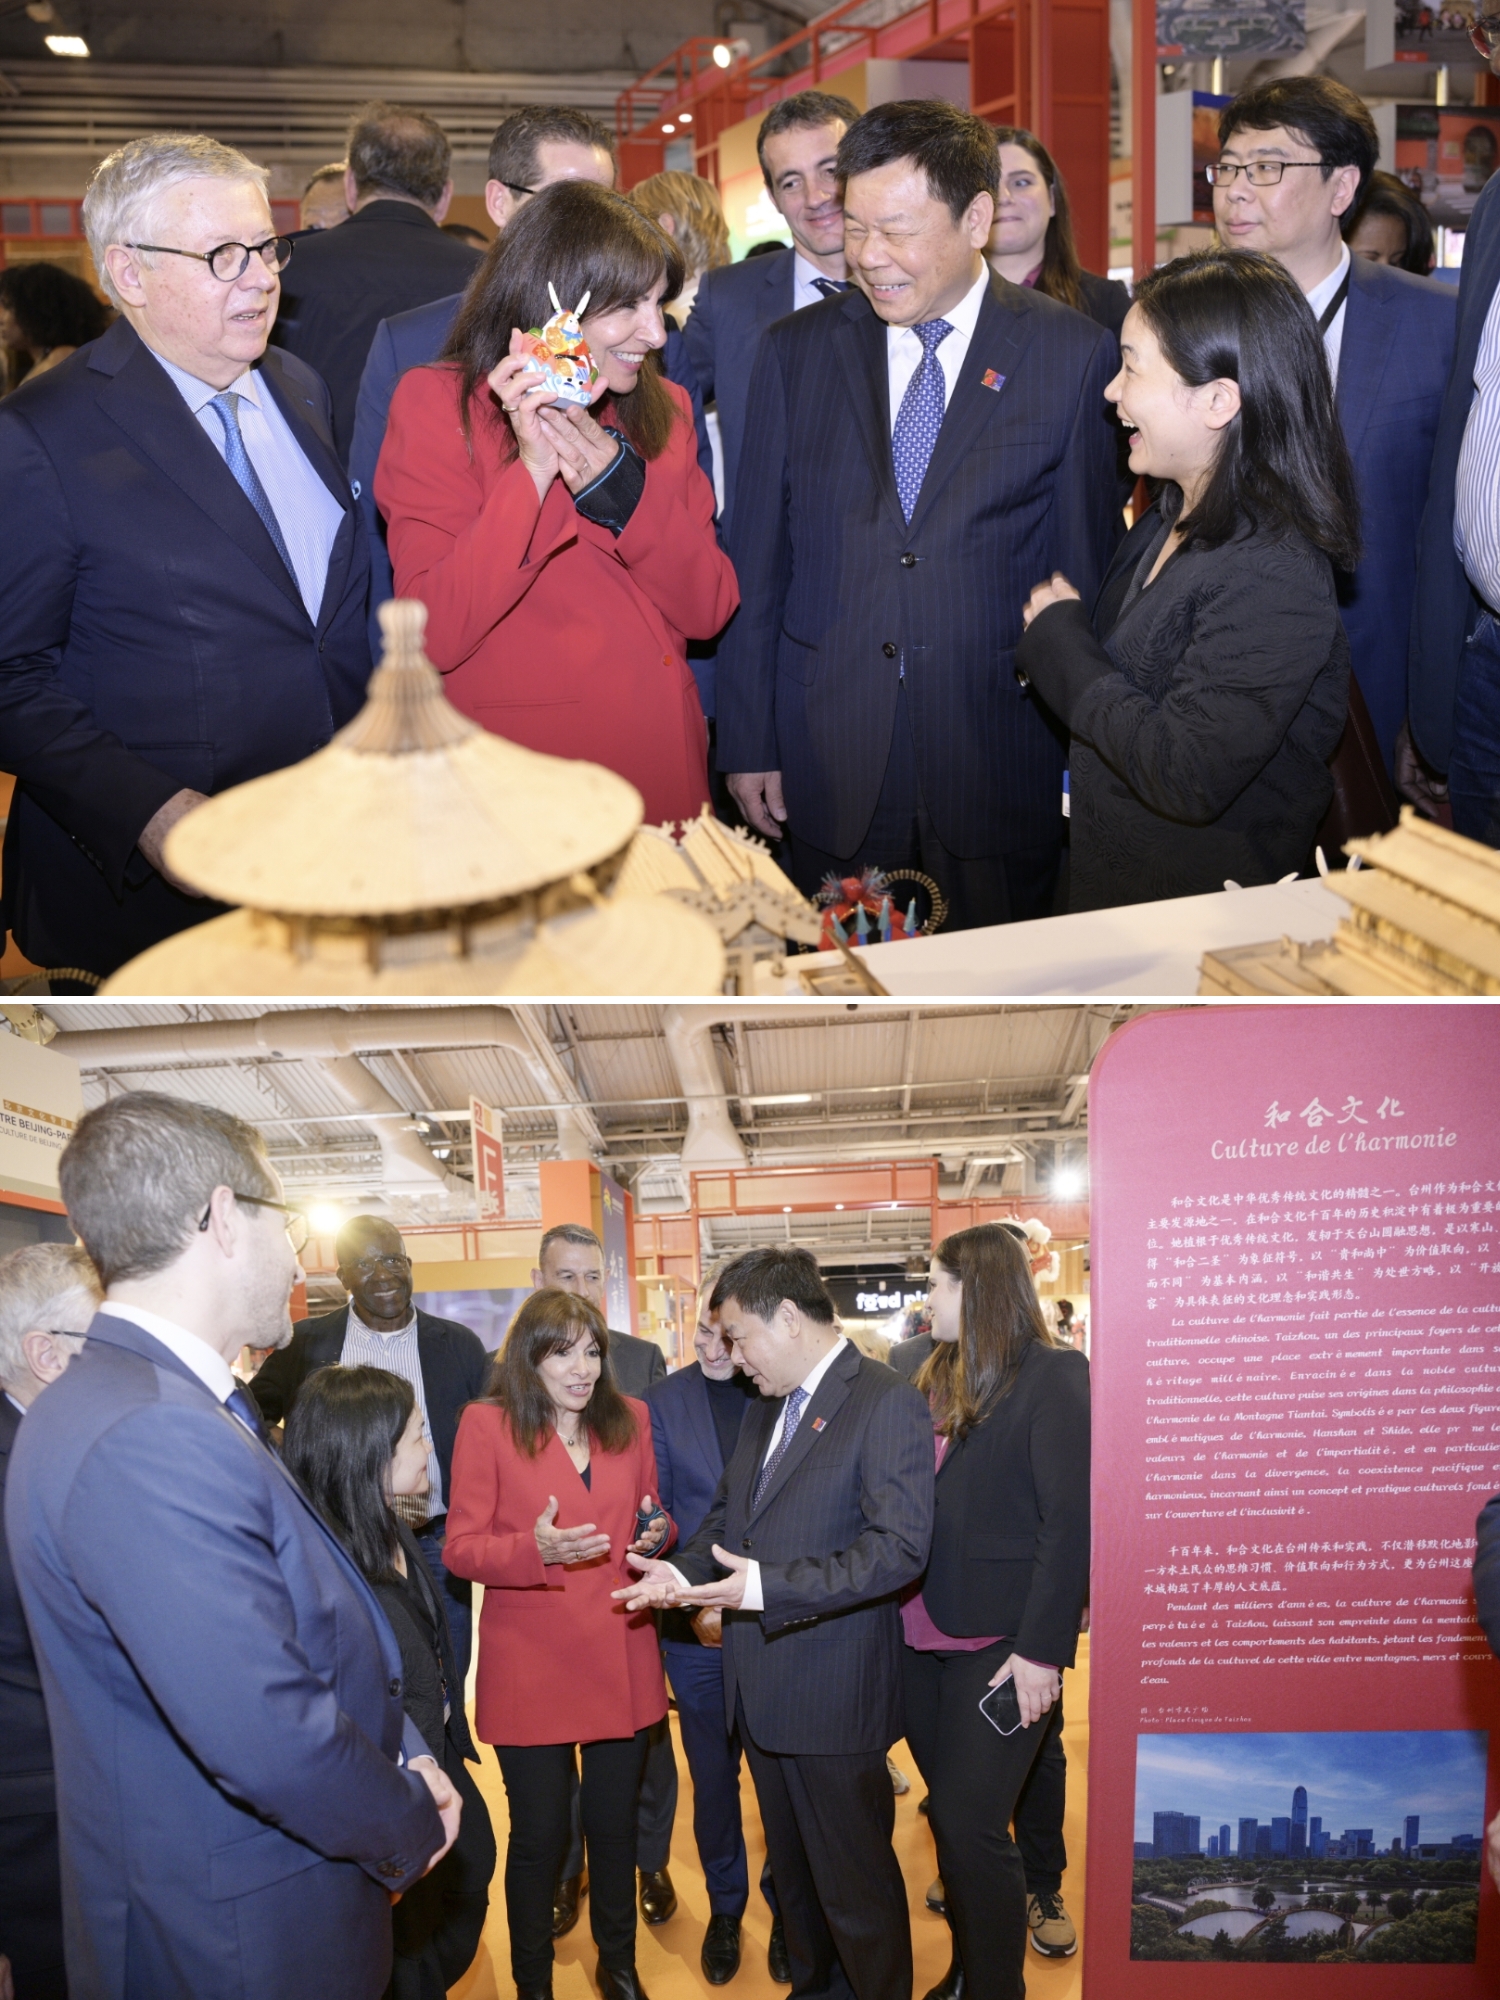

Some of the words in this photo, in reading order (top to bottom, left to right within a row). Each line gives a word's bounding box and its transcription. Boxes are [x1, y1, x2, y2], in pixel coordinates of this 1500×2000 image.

[1263, 1095, 1405, 1129] 和合文化
[1210, 1138, 1299, 1160] Culture
[1304, 1134, 1331, 1155] de
[1338, 1126, 1457, 1153] l'harmonie
[1171, 1317, 1186, 1327] La
[1188, 1316, 1229, 1325] culture
[1232, 1314, 1247, 1324] de
[1309, 1311, 1330, 1322] fait
[1334, 1309, 1368, 1321] partie
[1371, 1308, 1386, 1318] de
[1438, 1305, 1454, 1315] de
[1457, 1305, 1468, 1314] la
[1146, 1336, 1220, 1347] traditionnelle
[1324, 1332, 1339, 1340] un
[1342, 1329, 1361, 1339] des
[1365, 1328, 1424, 1339] principaux
[1428, 1326, 1463, 1336] foyers
[1466, 1324, 1481, 1334] de
[1197, 1356, 1236, 1366] occupe
[1242, 1355, 1264, 1363] une
[1271, 1353, 1301, 1363] place
[1392, 1346, 1451, 1357] importante
[1458, 1344, 1485, 1354] dans
[1364, 1368, 1391, 1377] dans
[1400, 1366, 1414, 1376] la
[1422, 1365, 1456, 1375] noble
[1225, 1393, 1252, 1402] cette
[1255, 1392, 1295, 1401] culture
[1298, 1390, 1325, 1401] puise
[1327, 1390, 1345, 1399] ses
[1347, 1388, 1389, 1398] origines
[1391, 1386, 1418, 1396] dans
[1419, 1385, 1432, 1395] la
[1434, 1384, 1494, 1396] philosophie
[1202, 1413, 1217, 1423] de
[1218, 1413, 1231, 1422] la
[1234, 1412, 1284, 1421] Montagne
[1397, 1408, 1416, 1417] par
[1420, 1405, 1437, 1415] les
[1438, 1404, 1466, 1414] deux
[1229, 1431, 1244, 1441] de
[1313, 1428, 1357, 1437] Hanshan
[1363, 1426, 1376, 1436] et
[1418, 1424, 1442, 1434] elle
[1145, 1453, 1186, 1463] valeurs
[1192, 1452, 1207, 1462] de
[1276, 1449, 1287, 1458] et
[1295, 1448, 1309, 1458] de
[1403, 1444, 1416, 1454] et
[1423, 1446, 1437, 1454] en
[1210, 1470, 1237, 1480] dans
[1244, 1469, 1258, 1479] la
[1336, 1466, 1350, 1476] la
[1358, 1465, 1423, 1474] coexistence
[1432, 1463, 1484, 1474] pacifique
[1210, 1489, 1261, 1498] incarnant
[1263, 1487, 1290, 1497] ainsi
[1308, 1486, 1349, 1496] concept
[1351, 1485, 1362, 1494] et
[1366, 1484, 1411, 1495] pratique
[1414, 1483, 1463, 1492] culturels
[1144, 1512, 1163, 1520] sur
[1225, 1507, 1238, 1517] et
[1167, 1602, 1207, 1611] Pendant
[1211, 1601, 1230, 1611] des
[1233, 1600, 1274, 1610] milliers
[1334, 1599, 1348, 1608] la
[1351, 1598, 1391, 1607] culture
[1395, 1597, 1410, 1607] de
[1211, 1619, 1219, 1629] à
[1272, 1618, 1314, 1628] laissant
[1317, 1619, 1336, 1627] son
[1339, 1617, 1389, 1627] empreinte
[1392, 1616, 1418, 1625] dans
[1421, 1615, 1434, 1625] la
[1437, 1615, 1477, 1624] mentali
[1141, 1639, 1157, 1649] les
[1158, 1639, 1199, 1648] valeurs
[1200, 1638, 1213, 1648] et
[1213, 1638, 1230, 1647] les
[1232, 1637, 1306, 1647] comportements
[1307, 1636, 1326, 1646] des
[1383, 1635, 1415, 1645] jetant
[1417, 1634, 1434, 1643] les
[1141, 1657, 1186, 1668] profonds
[1188, 1656, 1202, 1666] de
[1203, 1656, 1215, 1666] la
[1262, 1655, 1276, 1665] de
[1277, 1655, 1305, 1664] cette
[1306, 1654, 1332, 1664] ville
[1332, 1654, 1363, 1664] entre
[1422, 1654, 1447, 1662] mers
[1448, 1652, 1461, 1661] et
[1462, 1653, 1493, 1661] cours
